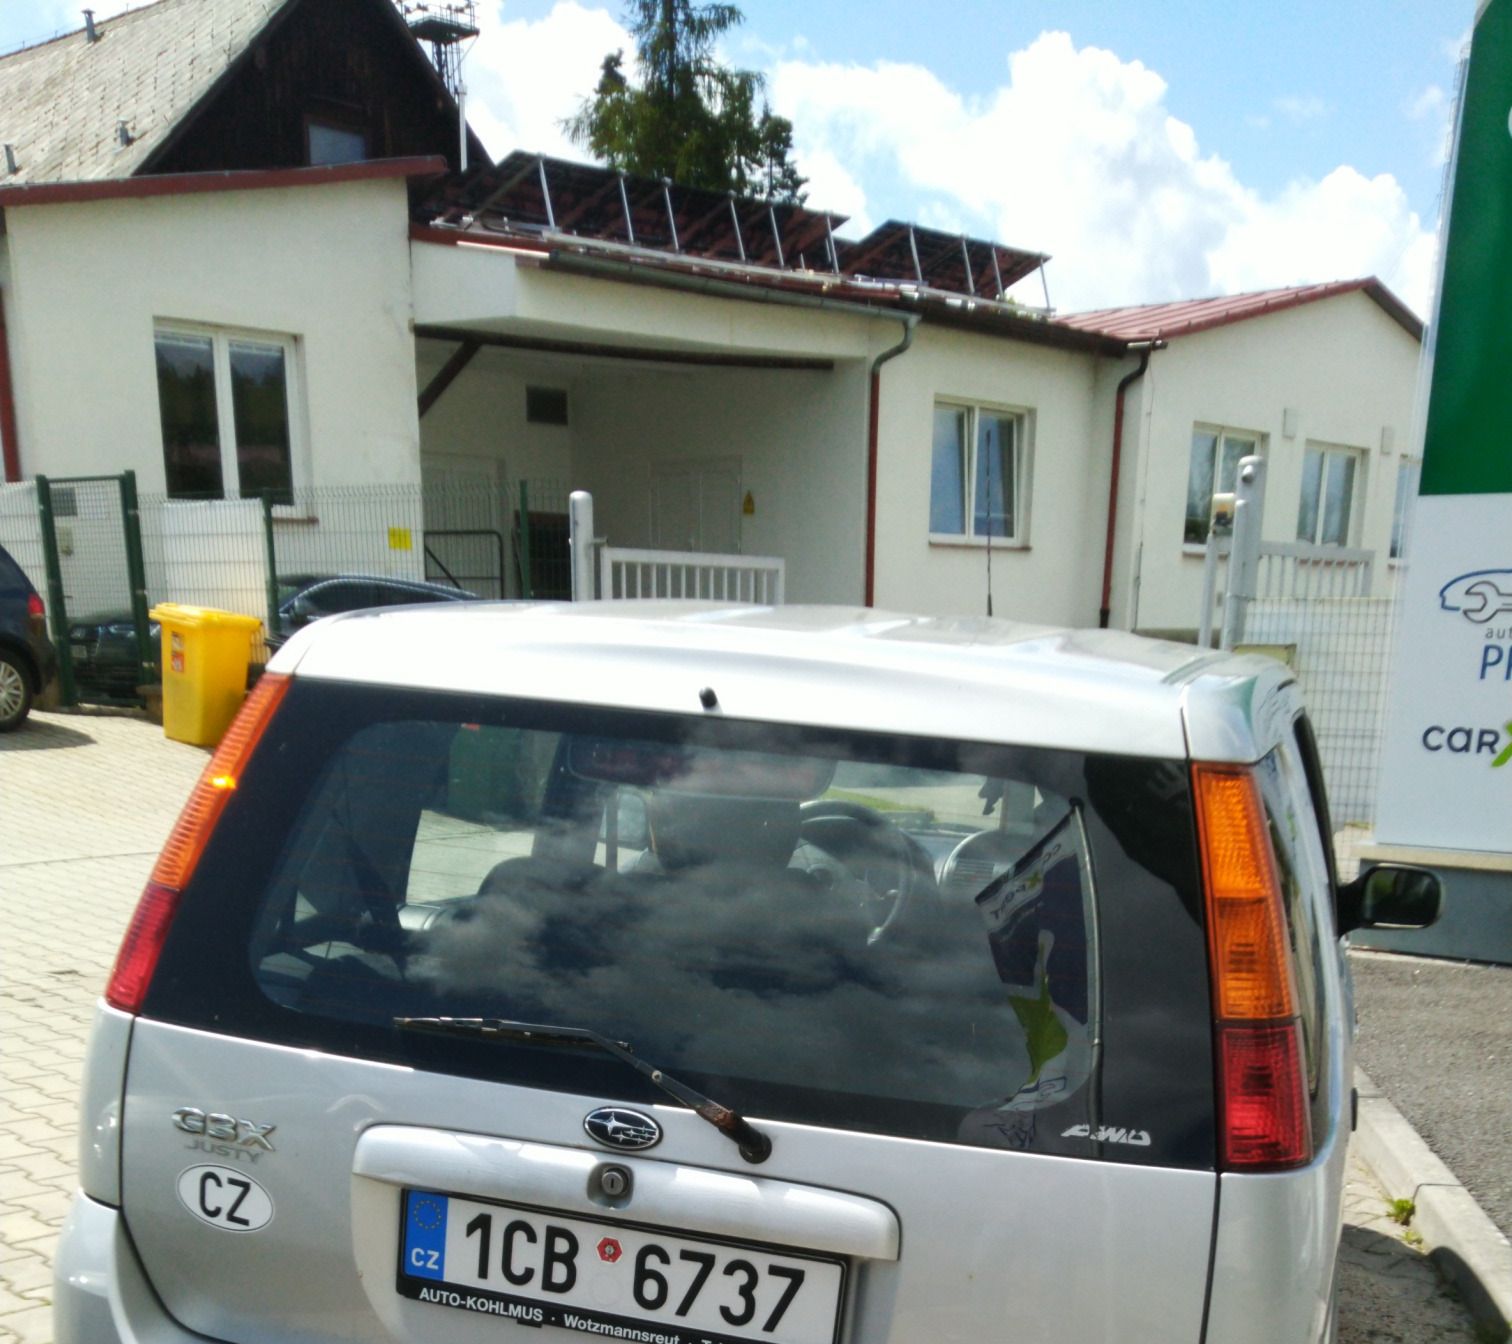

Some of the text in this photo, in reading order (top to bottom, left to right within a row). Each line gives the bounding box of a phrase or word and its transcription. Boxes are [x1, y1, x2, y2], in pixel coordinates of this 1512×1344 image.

[184, 1139, 264, 1162] JUSTY
[200, 1171, 251, 1226] CZ
[411, 1248, 439, 1271] CZ
[466, 1213, 806, 1333] 1CB 6737
[419, 1287, 543, 1322] AUTO-KOHLMUS
